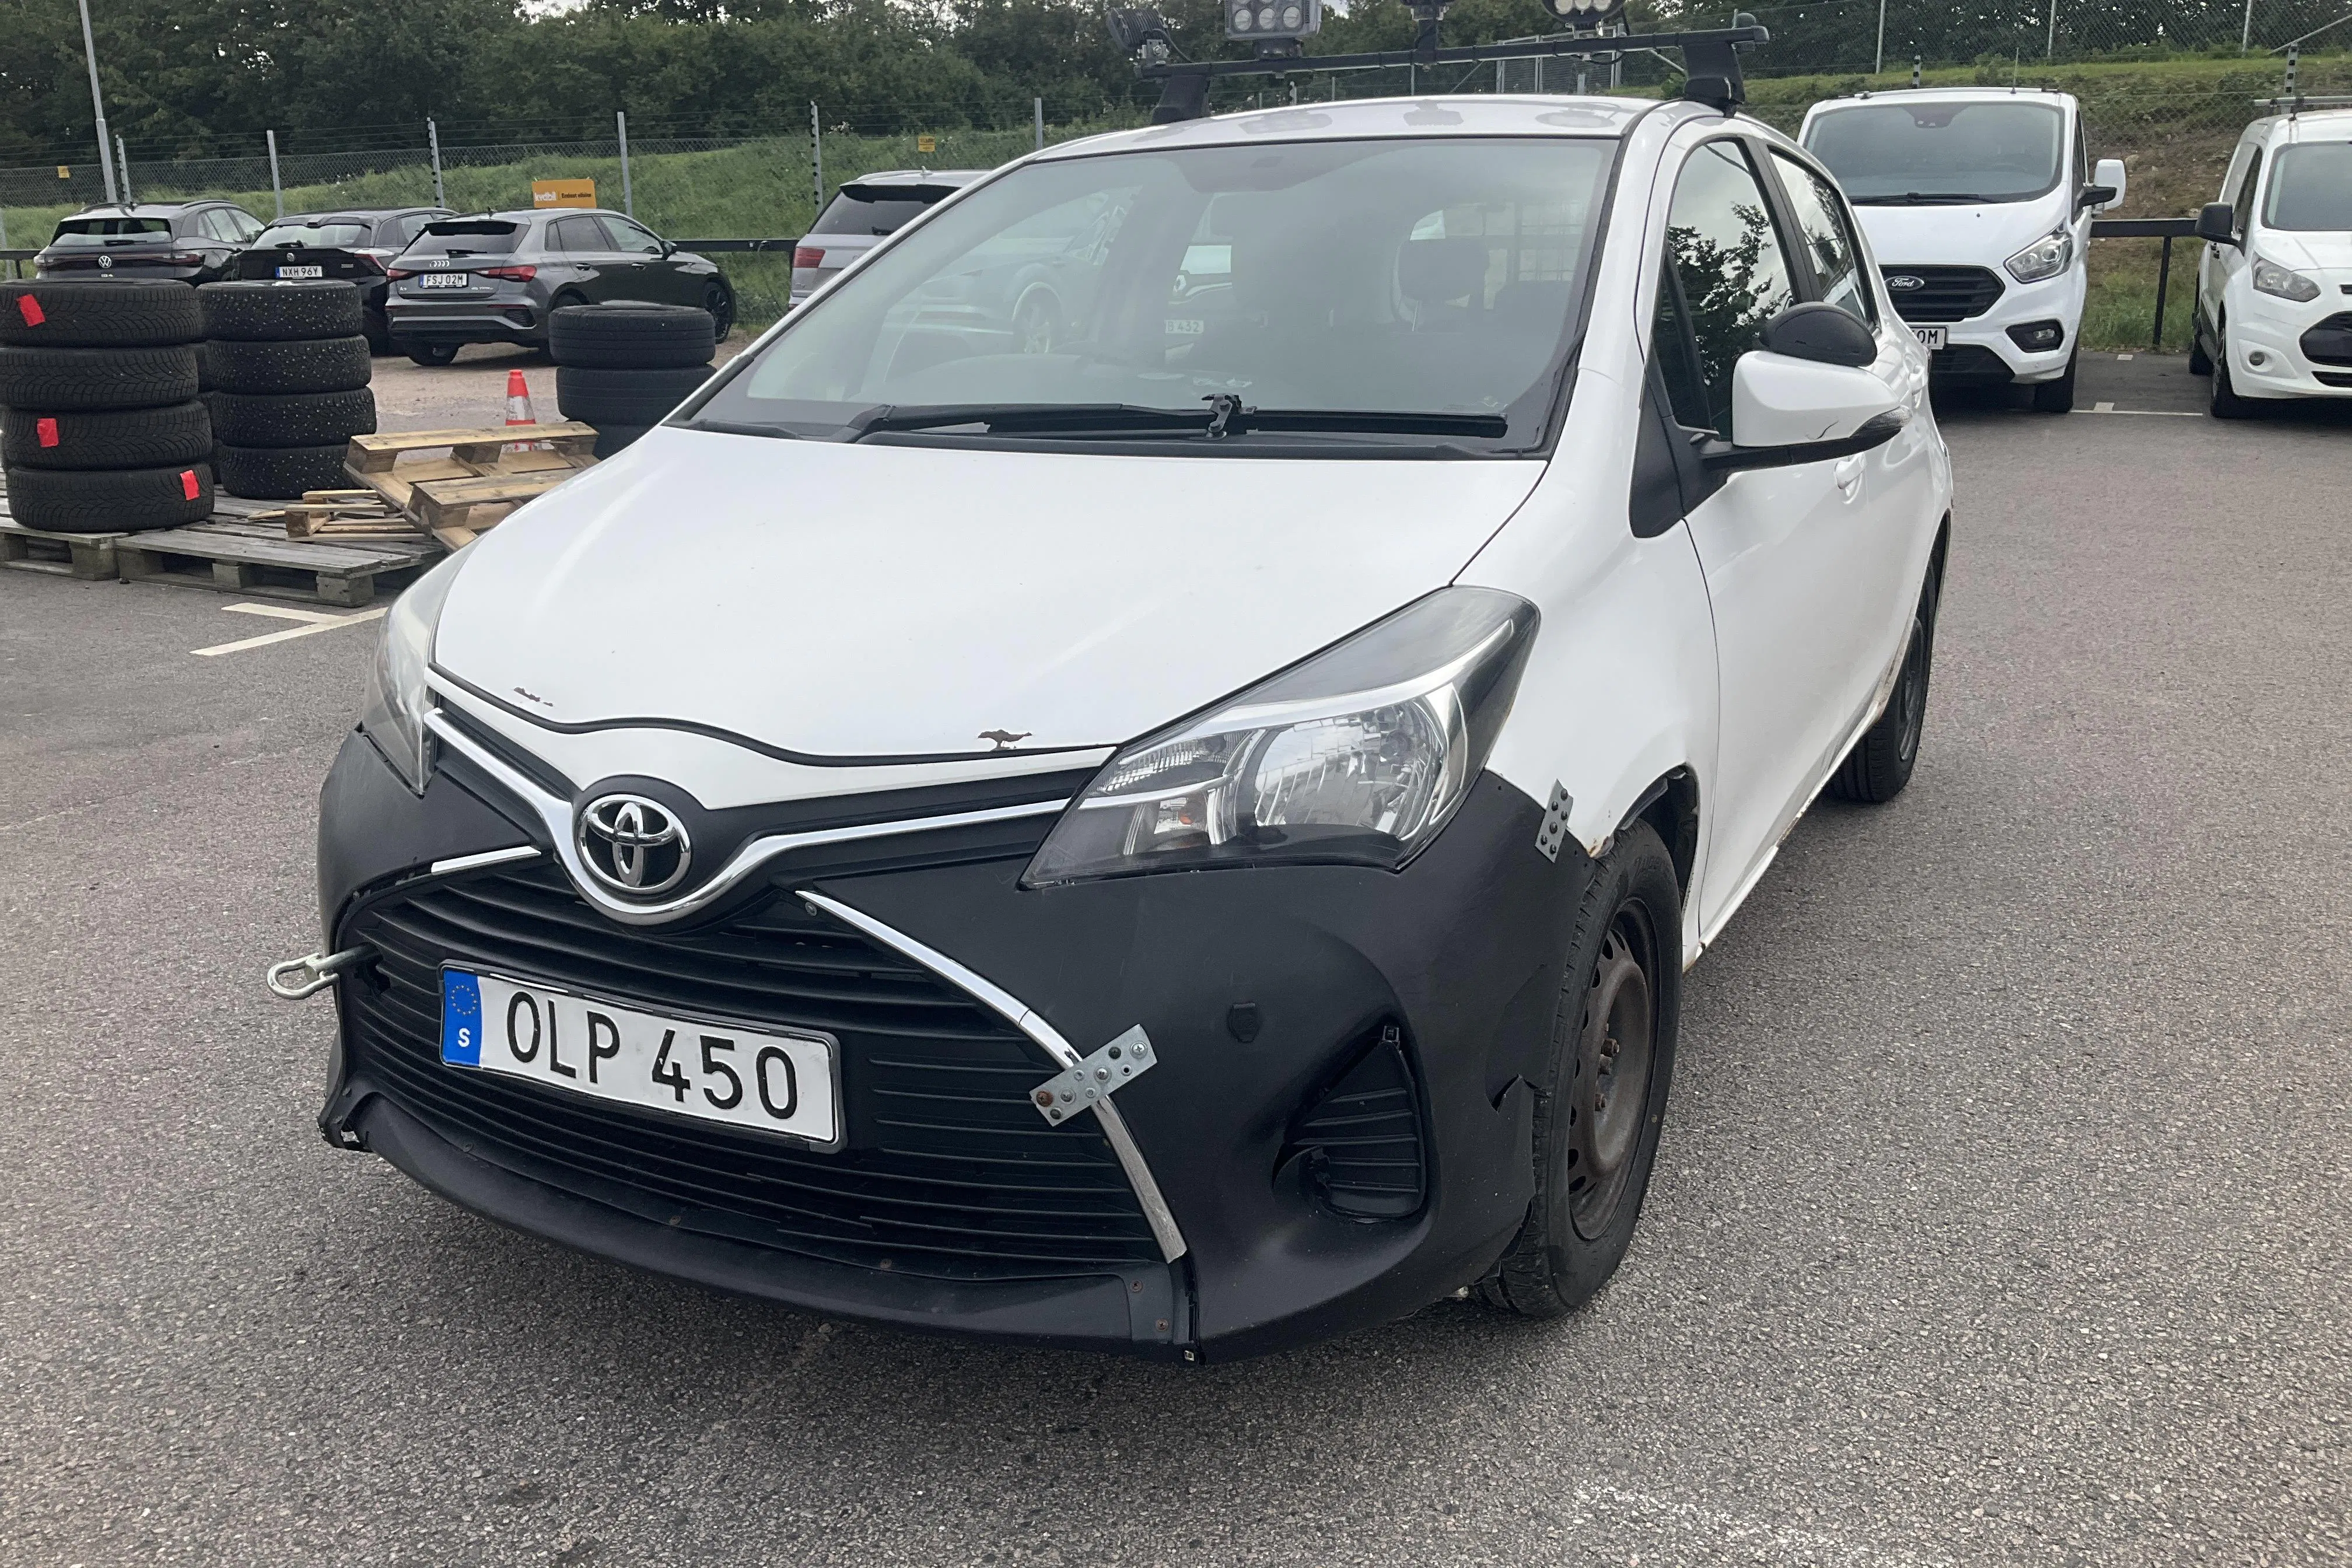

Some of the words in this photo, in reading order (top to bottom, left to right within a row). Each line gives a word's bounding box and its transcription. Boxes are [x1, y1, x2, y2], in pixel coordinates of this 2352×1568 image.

[282, 267, 299, 276] NXH
[301, 267, 318, 276] 96Y
[426, 275, 443, 285] FSJ
[446, 274, 463, 284] 02M
[1891, 278, 1915, 287] Ford
[1177, 321, 1199, 332] 432
[457, 1027, 471, 1048] S
[506, 991, 621, 1084] OLP
[652, 1028, 798, 1120] 450
